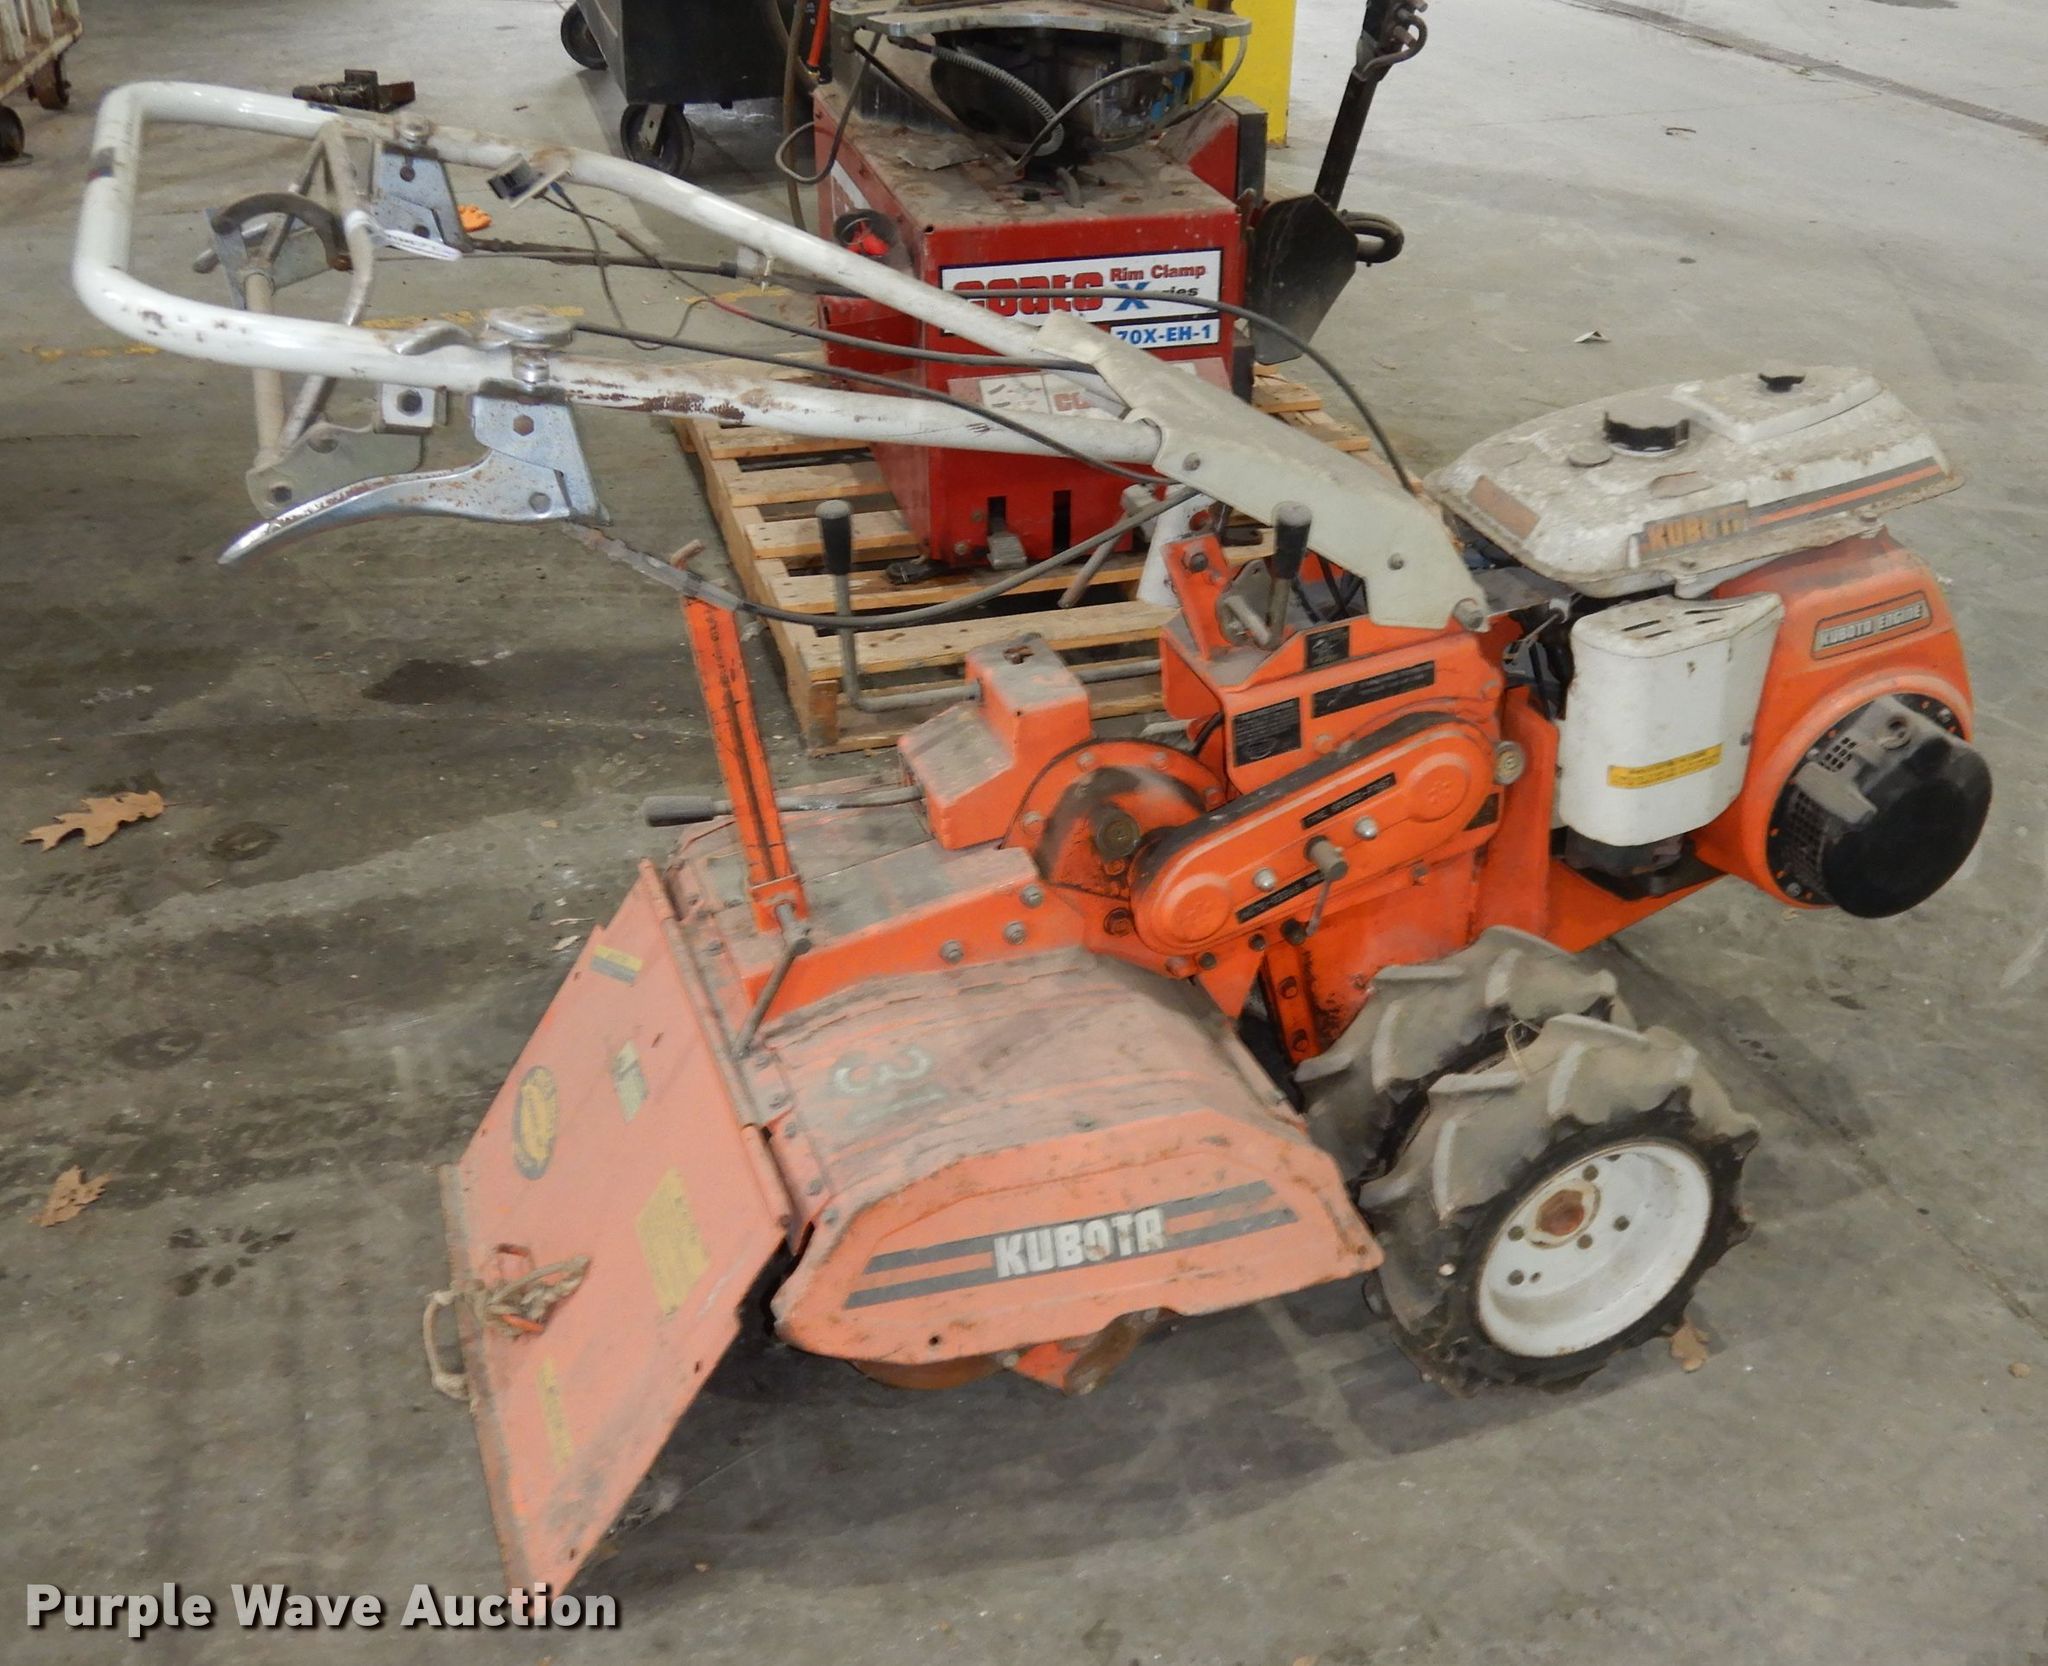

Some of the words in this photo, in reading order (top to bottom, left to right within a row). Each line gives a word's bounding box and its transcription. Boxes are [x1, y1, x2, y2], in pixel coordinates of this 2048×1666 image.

[1110, 267, 1144, 281] Rim
[1151, 264, 1206, 279] Clamp
[1114, 281, 1150, 311] X
[993, 1207, 1168, 1279] KUBOTA
